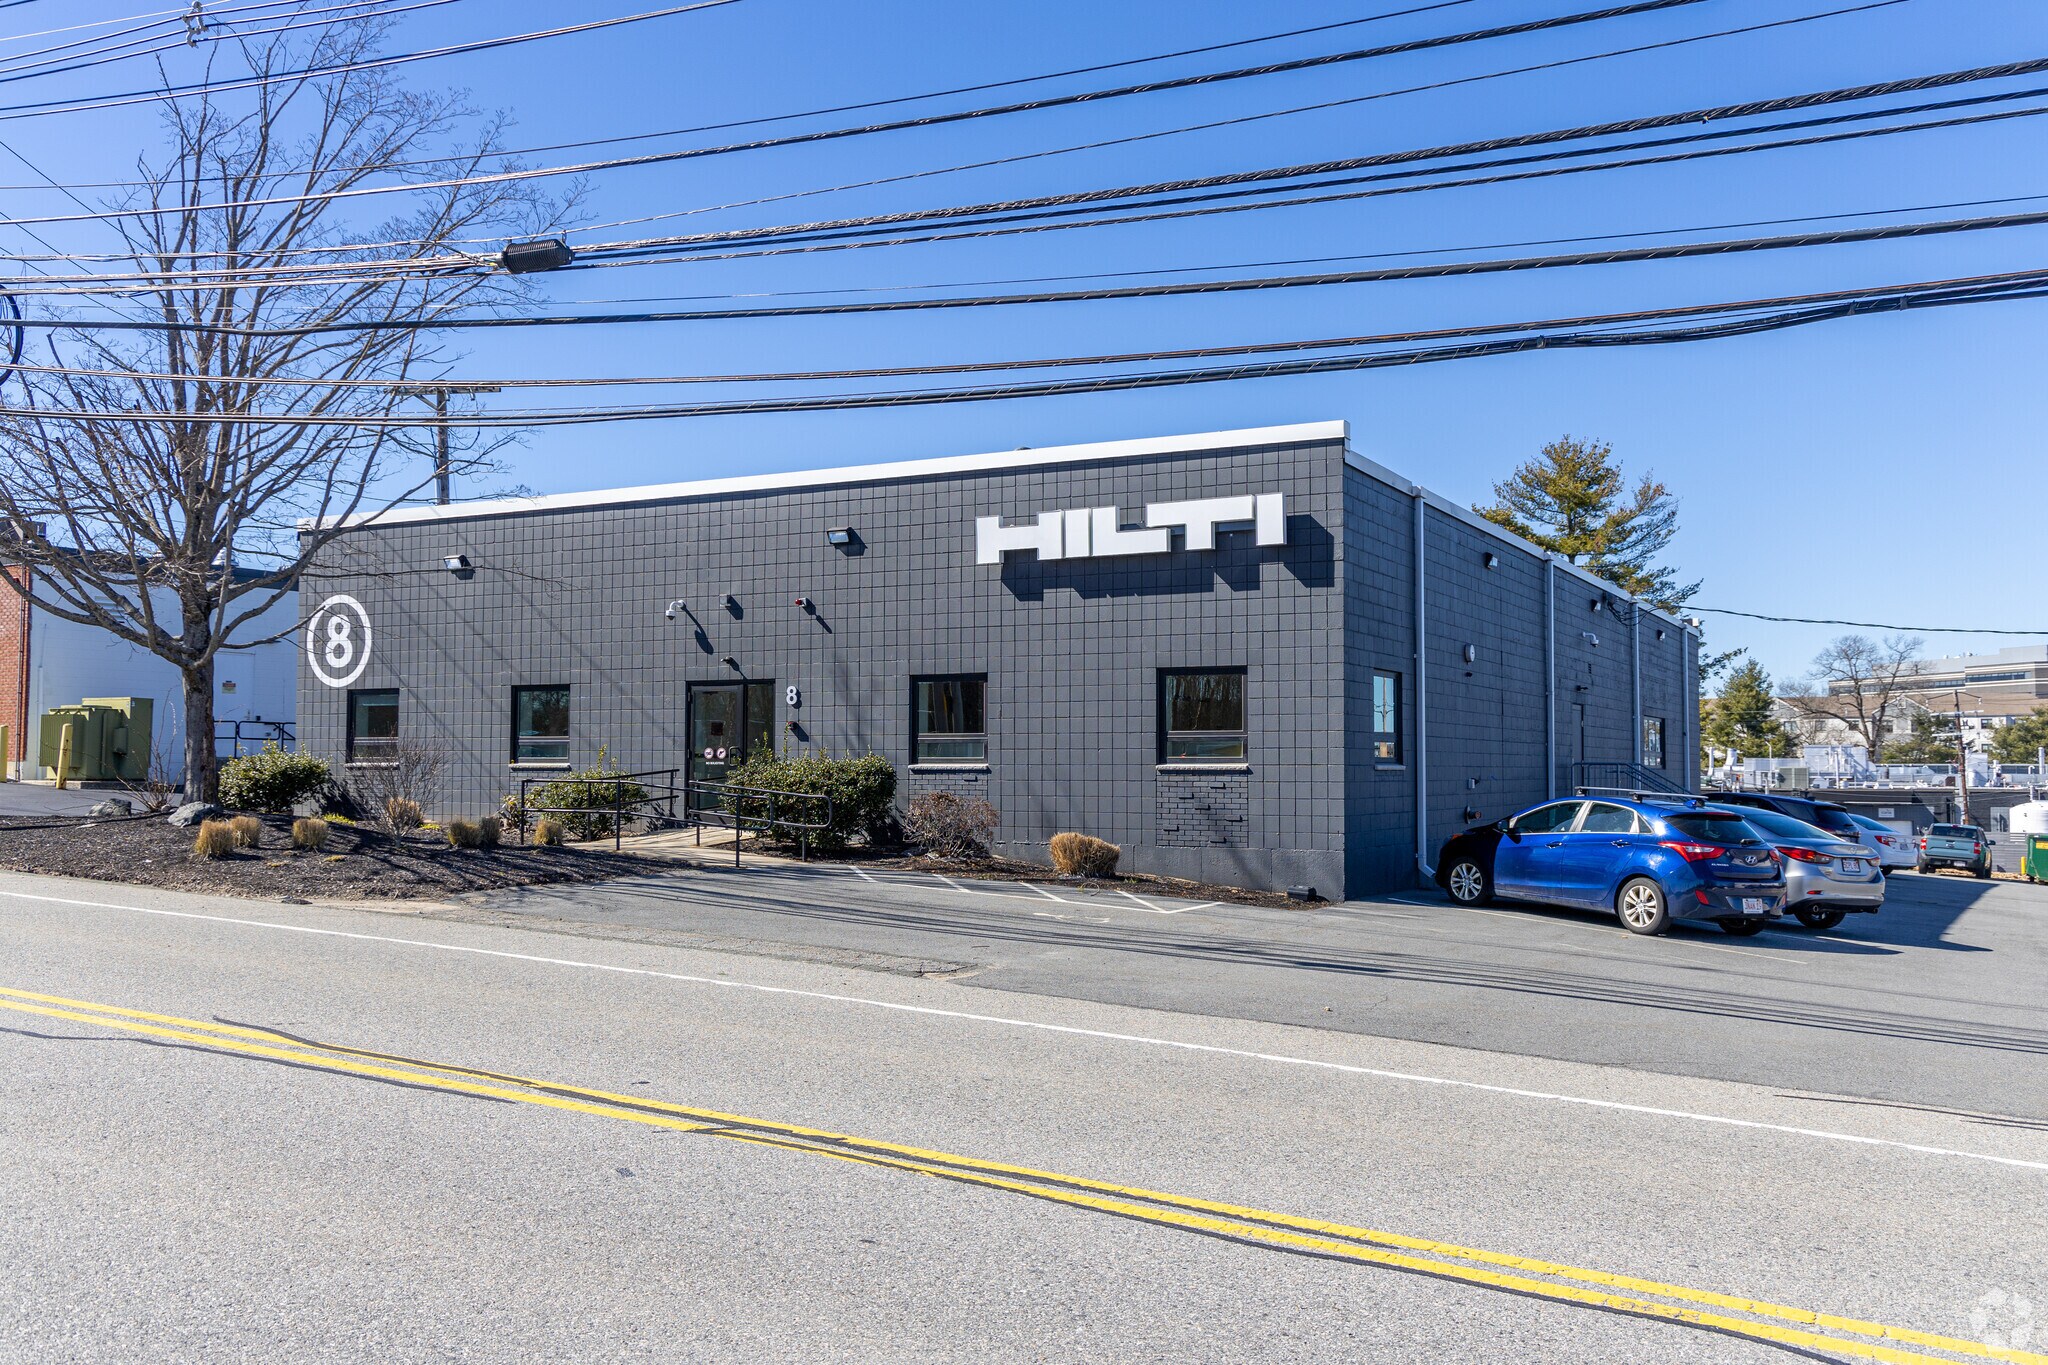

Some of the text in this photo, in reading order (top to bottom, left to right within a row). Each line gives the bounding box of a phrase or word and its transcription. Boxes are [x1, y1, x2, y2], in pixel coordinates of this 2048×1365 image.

[975, 492, 1287, 564] HILTI
[325, 614, 353, 668] 8
[786, 685, 798, 705] 8
